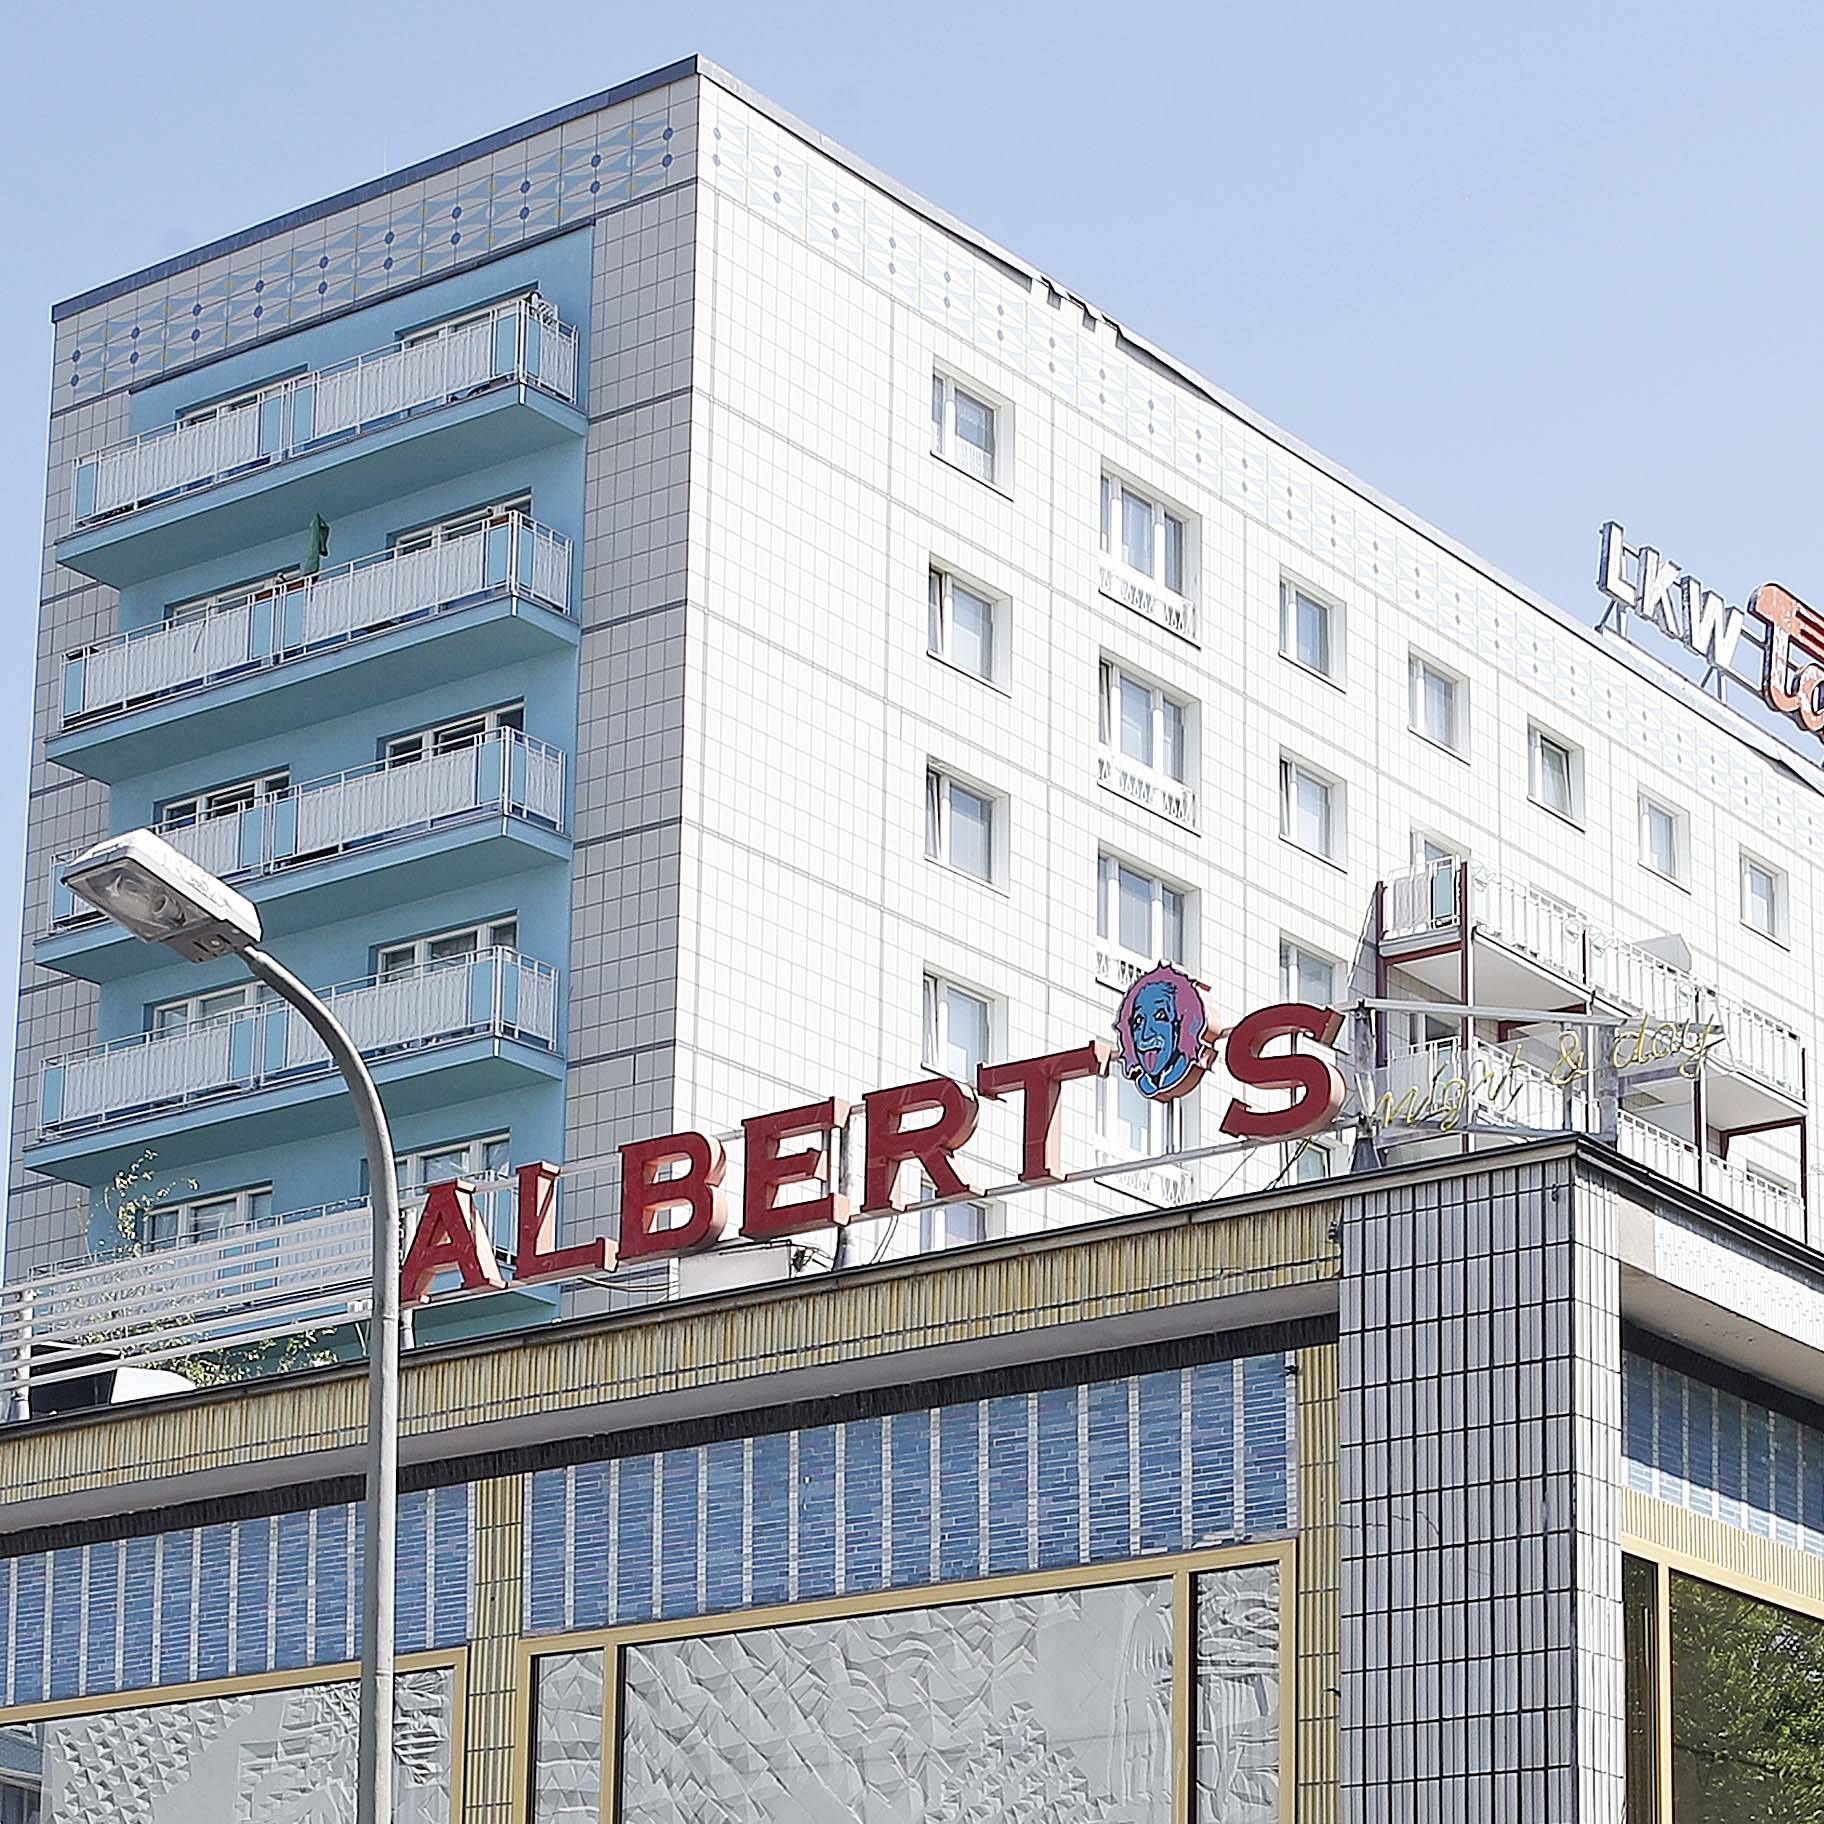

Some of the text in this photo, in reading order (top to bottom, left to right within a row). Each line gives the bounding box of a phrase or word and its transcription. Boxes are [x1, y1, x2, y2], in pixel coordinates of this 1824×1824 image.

[1599, 521, 1744, 669] LKW
[1375, 1012, 1718, 1131] night & day
